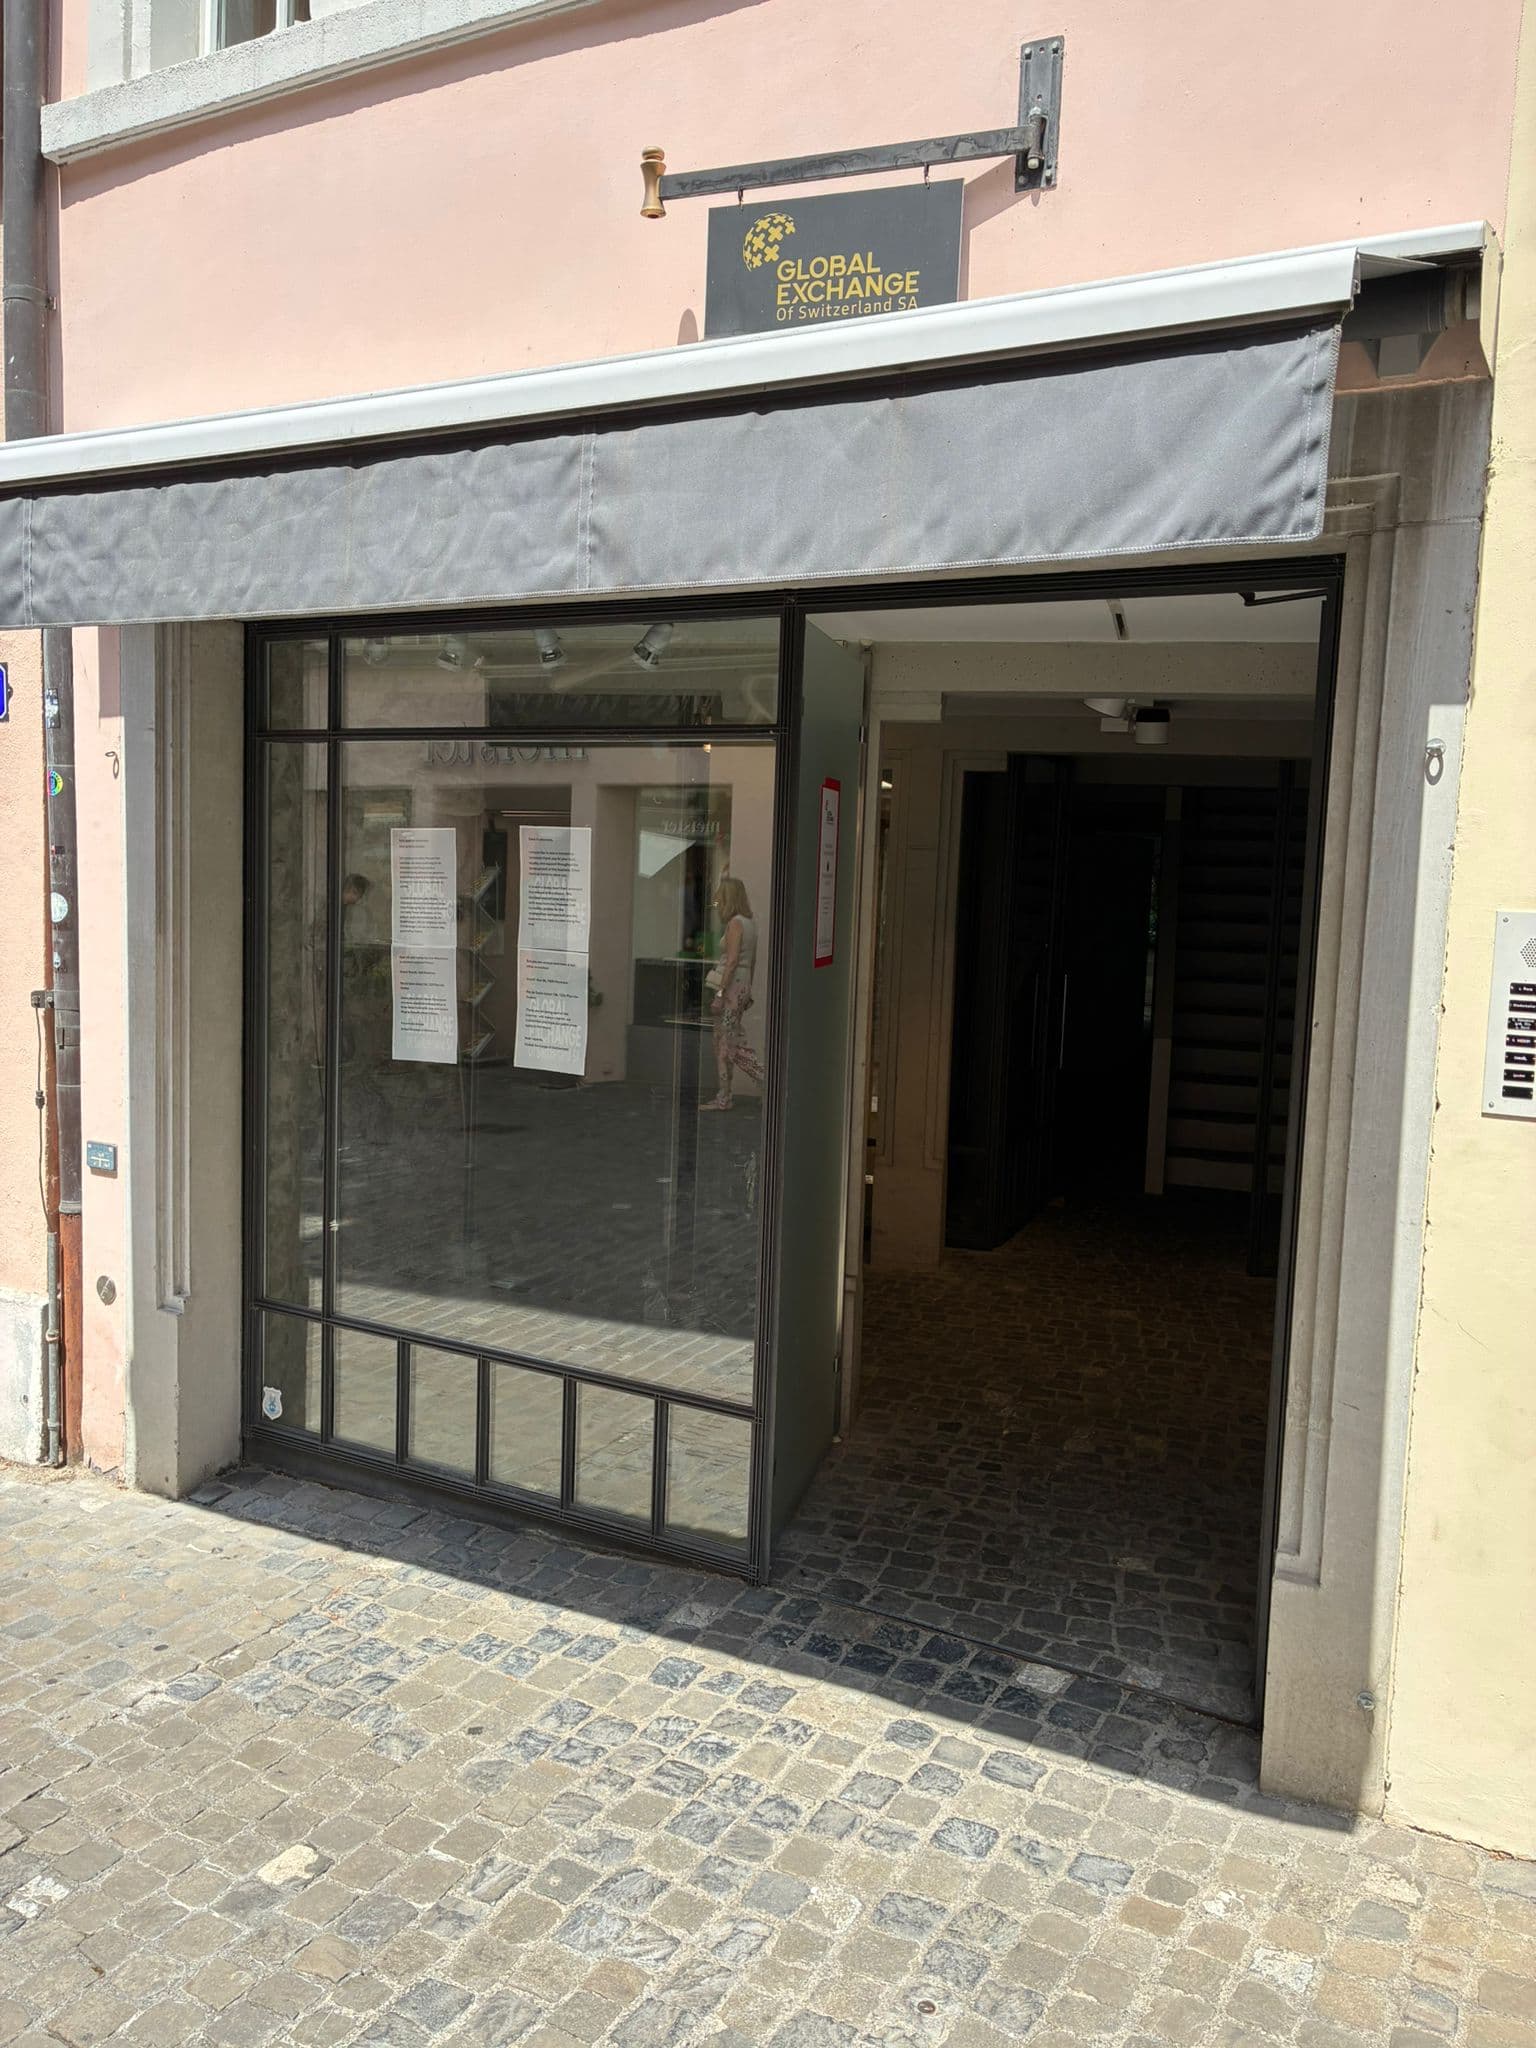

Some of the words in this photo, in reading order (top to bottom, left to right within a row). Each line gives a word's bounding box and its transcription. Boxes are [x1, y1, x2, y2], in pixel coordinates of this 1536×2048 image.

[776, 251, 881, 282] GLOBAL
[776, 270, 920, 305] EXCHANGE
[776, 305, 794, 321] Of
[798, 297, 892, 319] Switzerland
[898, 295, 918, 311] SA
